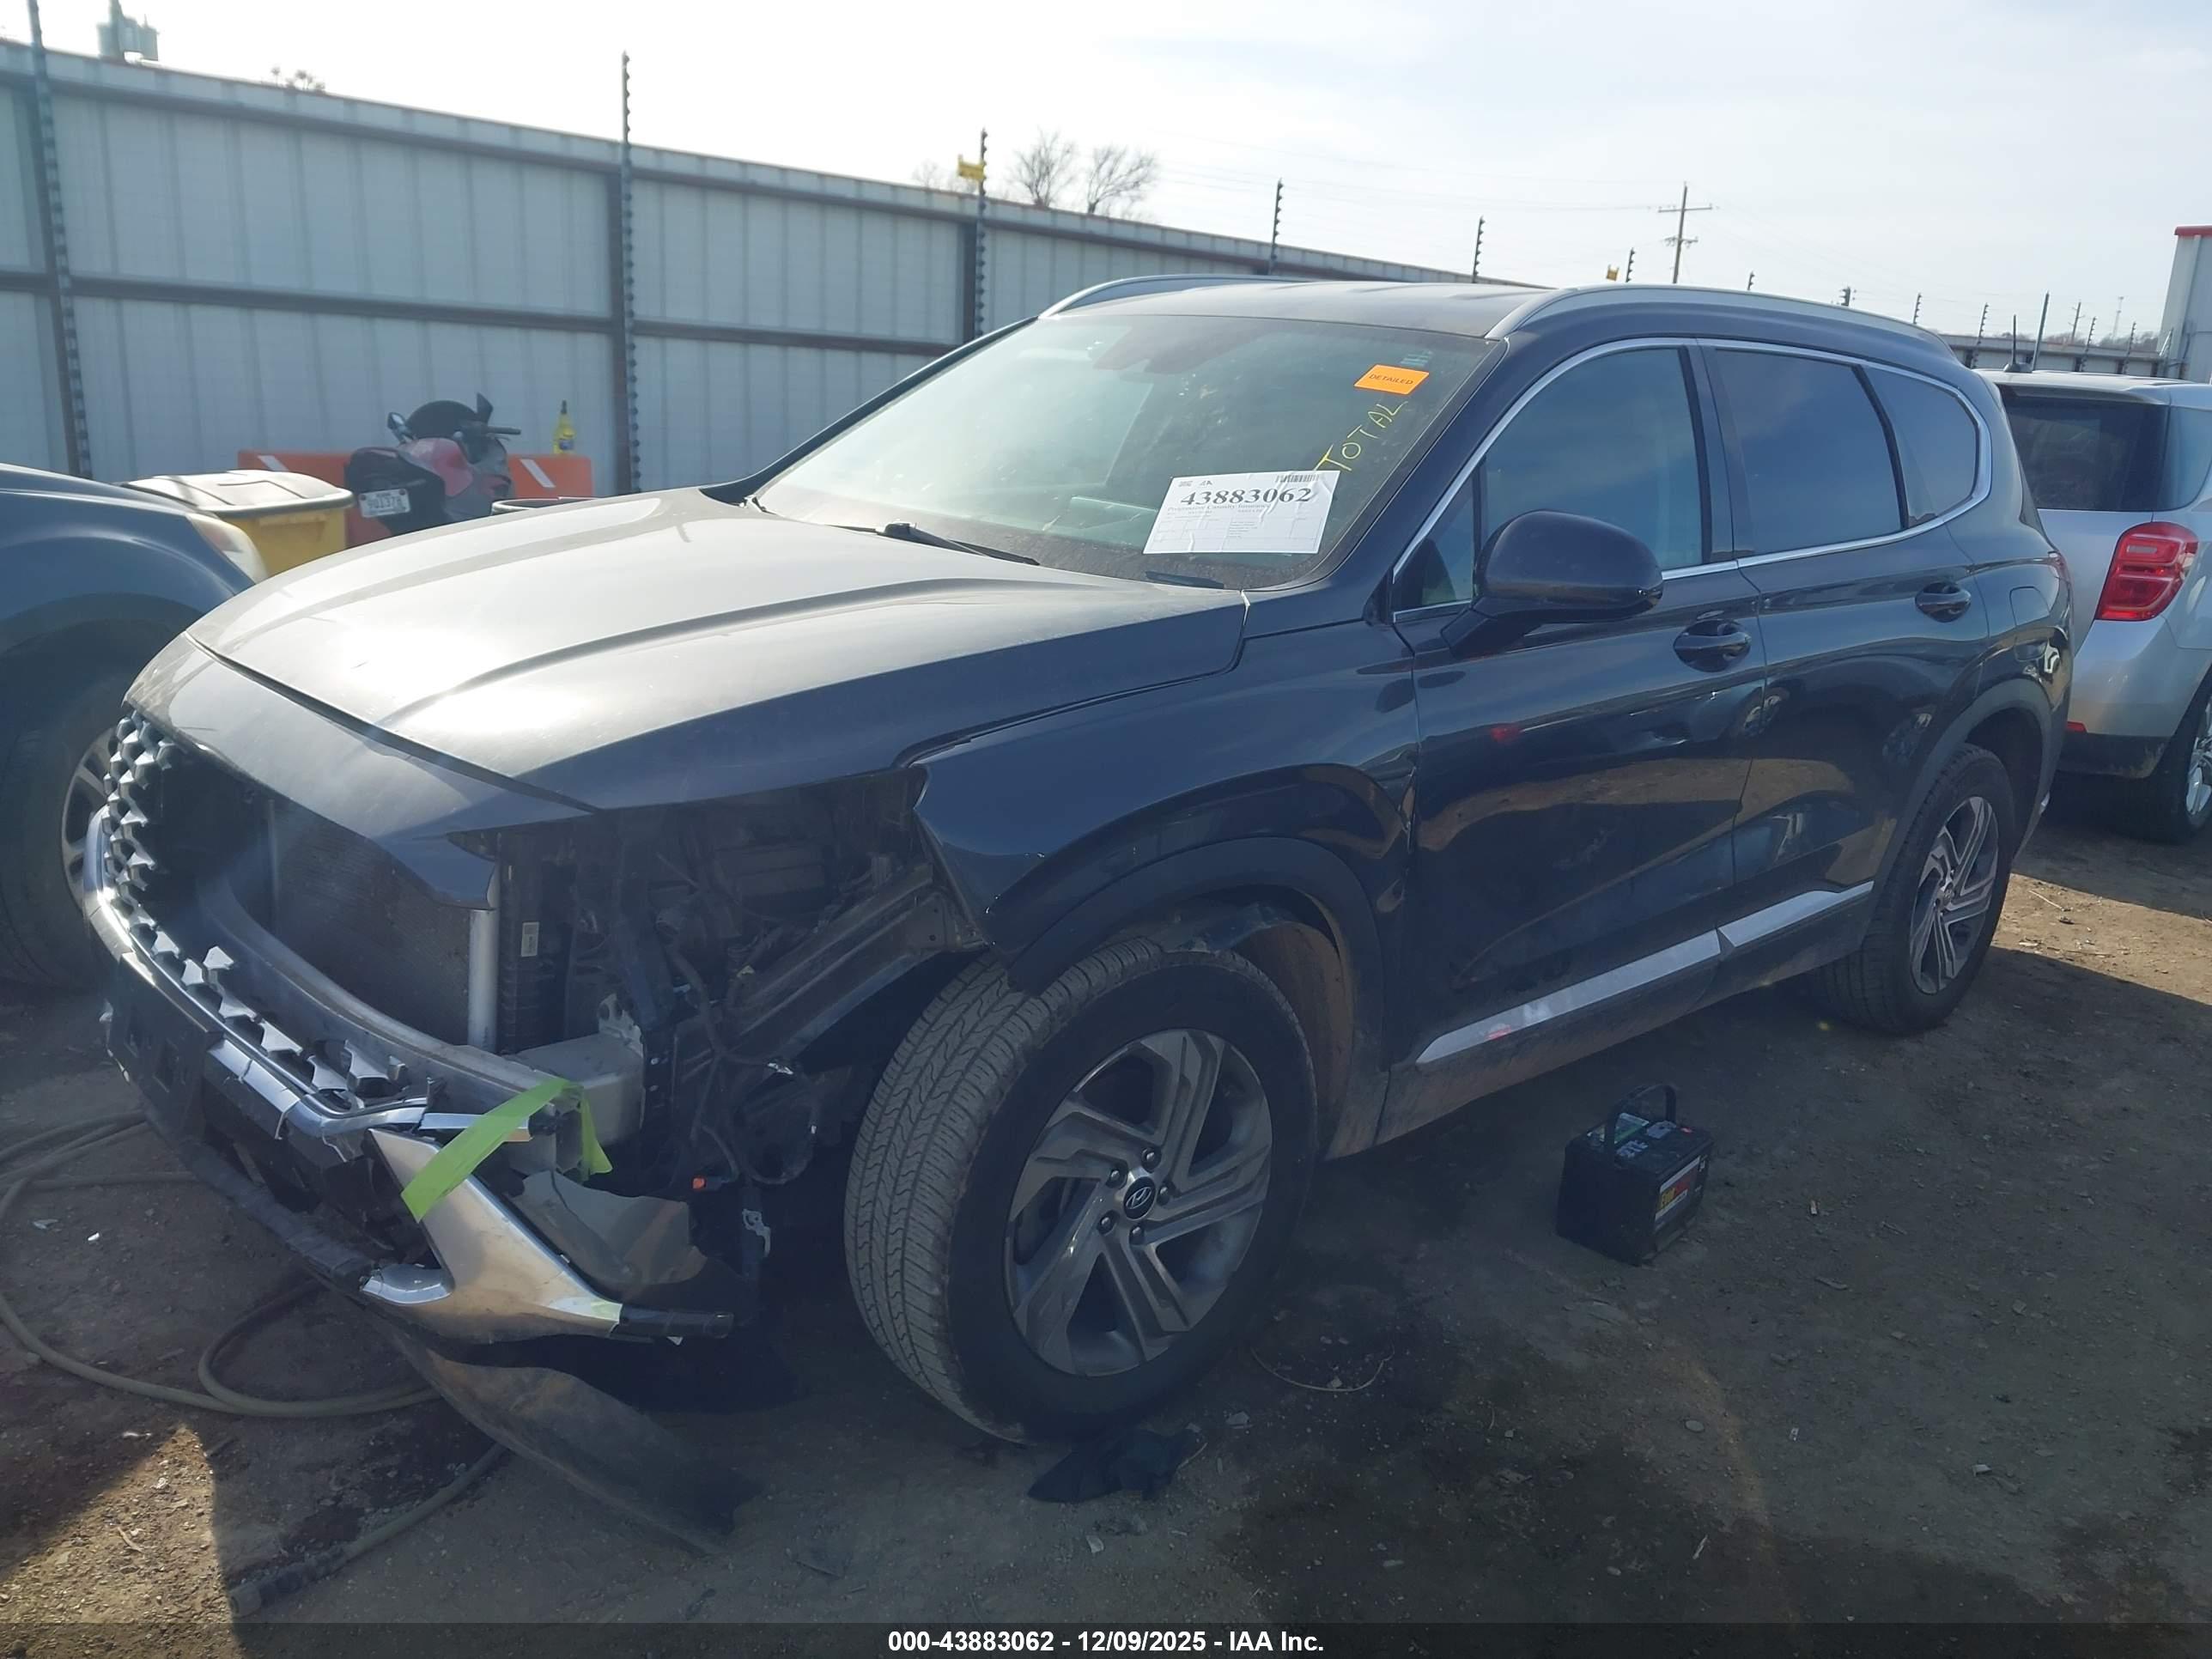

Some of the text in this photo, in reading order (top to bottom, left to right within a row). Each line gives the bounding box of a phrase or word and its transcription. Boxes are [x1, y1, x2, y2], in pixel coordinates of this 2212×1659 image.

[1369, 373, 1413, 386] DETAILED
[1313, 400, 1408, 471] TOTAL
[1180, 487, 1312, 506] 43883062
